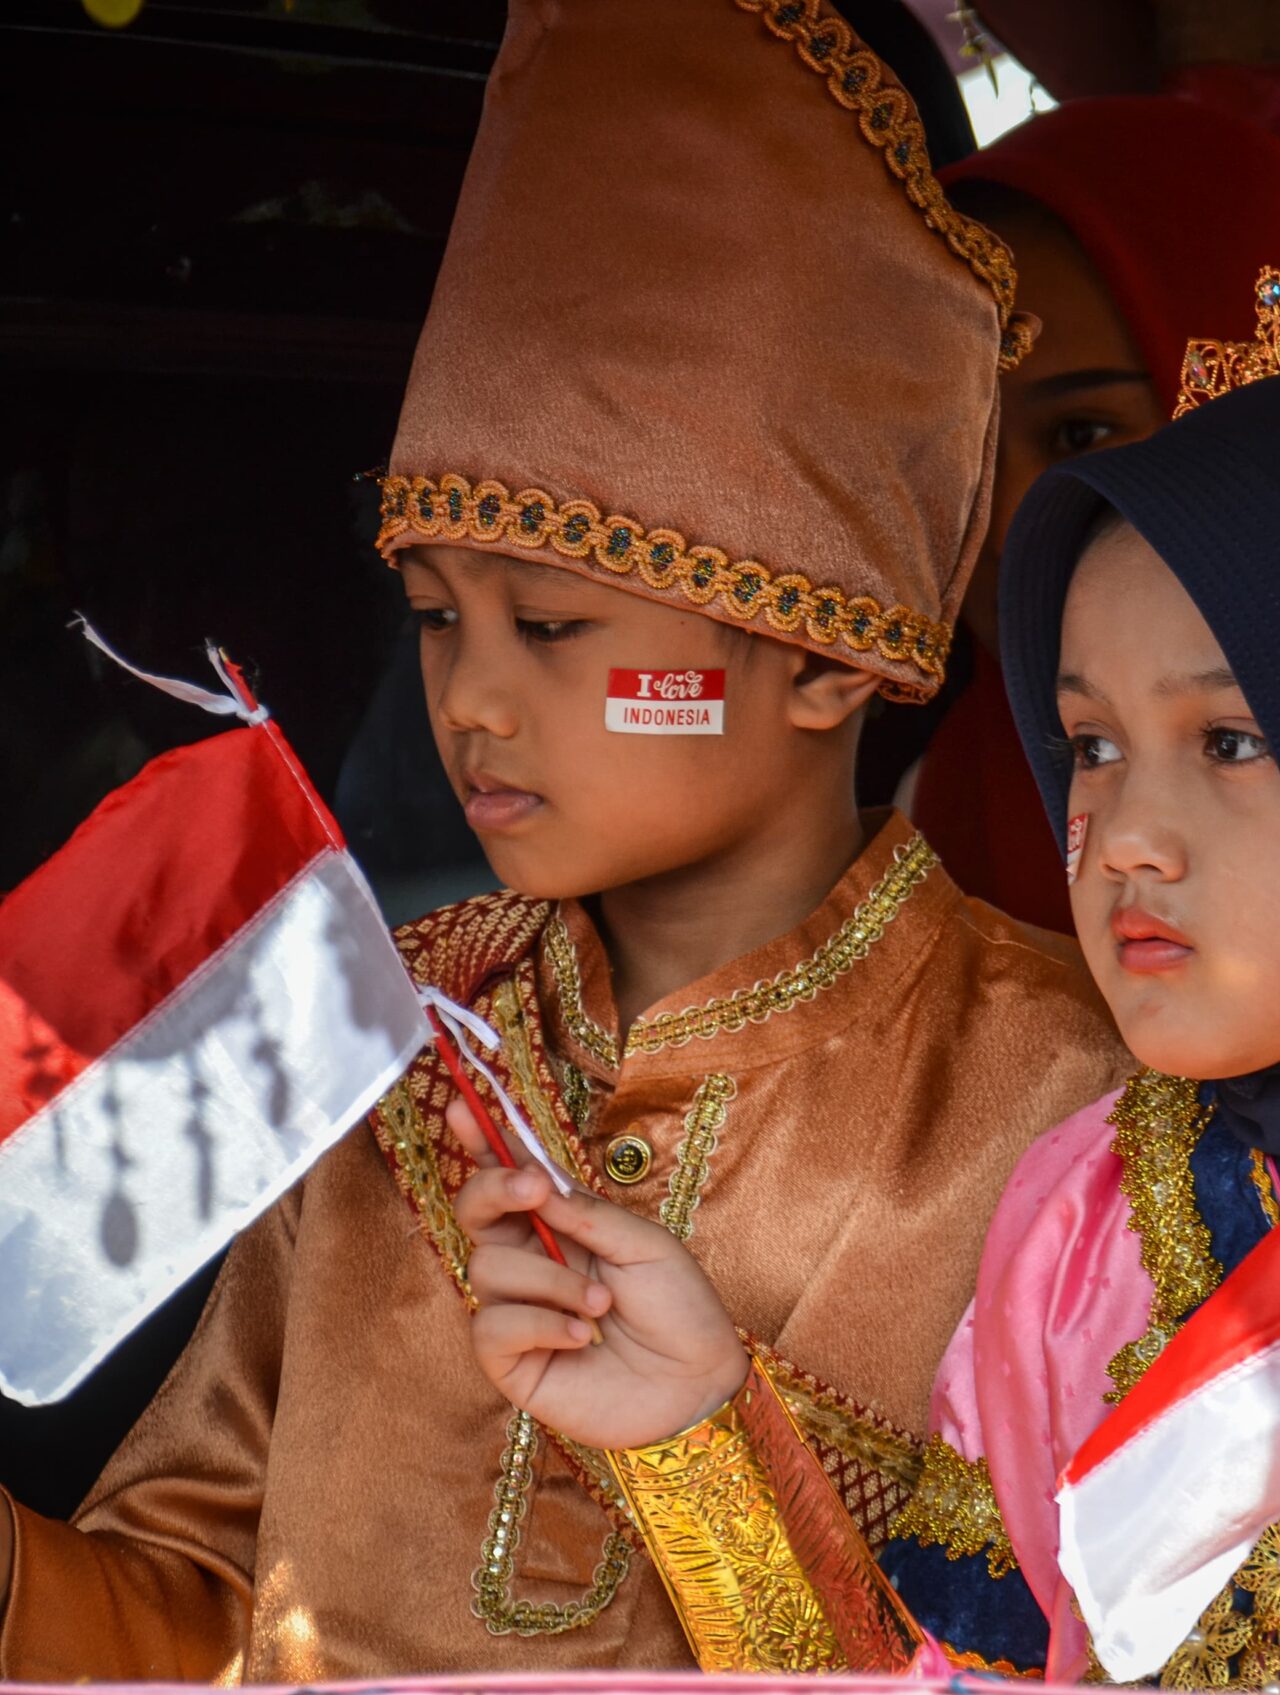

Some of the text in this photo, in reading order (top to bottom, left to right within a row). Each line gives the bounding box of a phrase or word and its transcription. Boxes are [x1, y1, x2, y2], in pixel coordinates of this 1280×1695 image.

[637, 670, 703, 699] I love
[623, 707, 710, 726] INDONESIA
